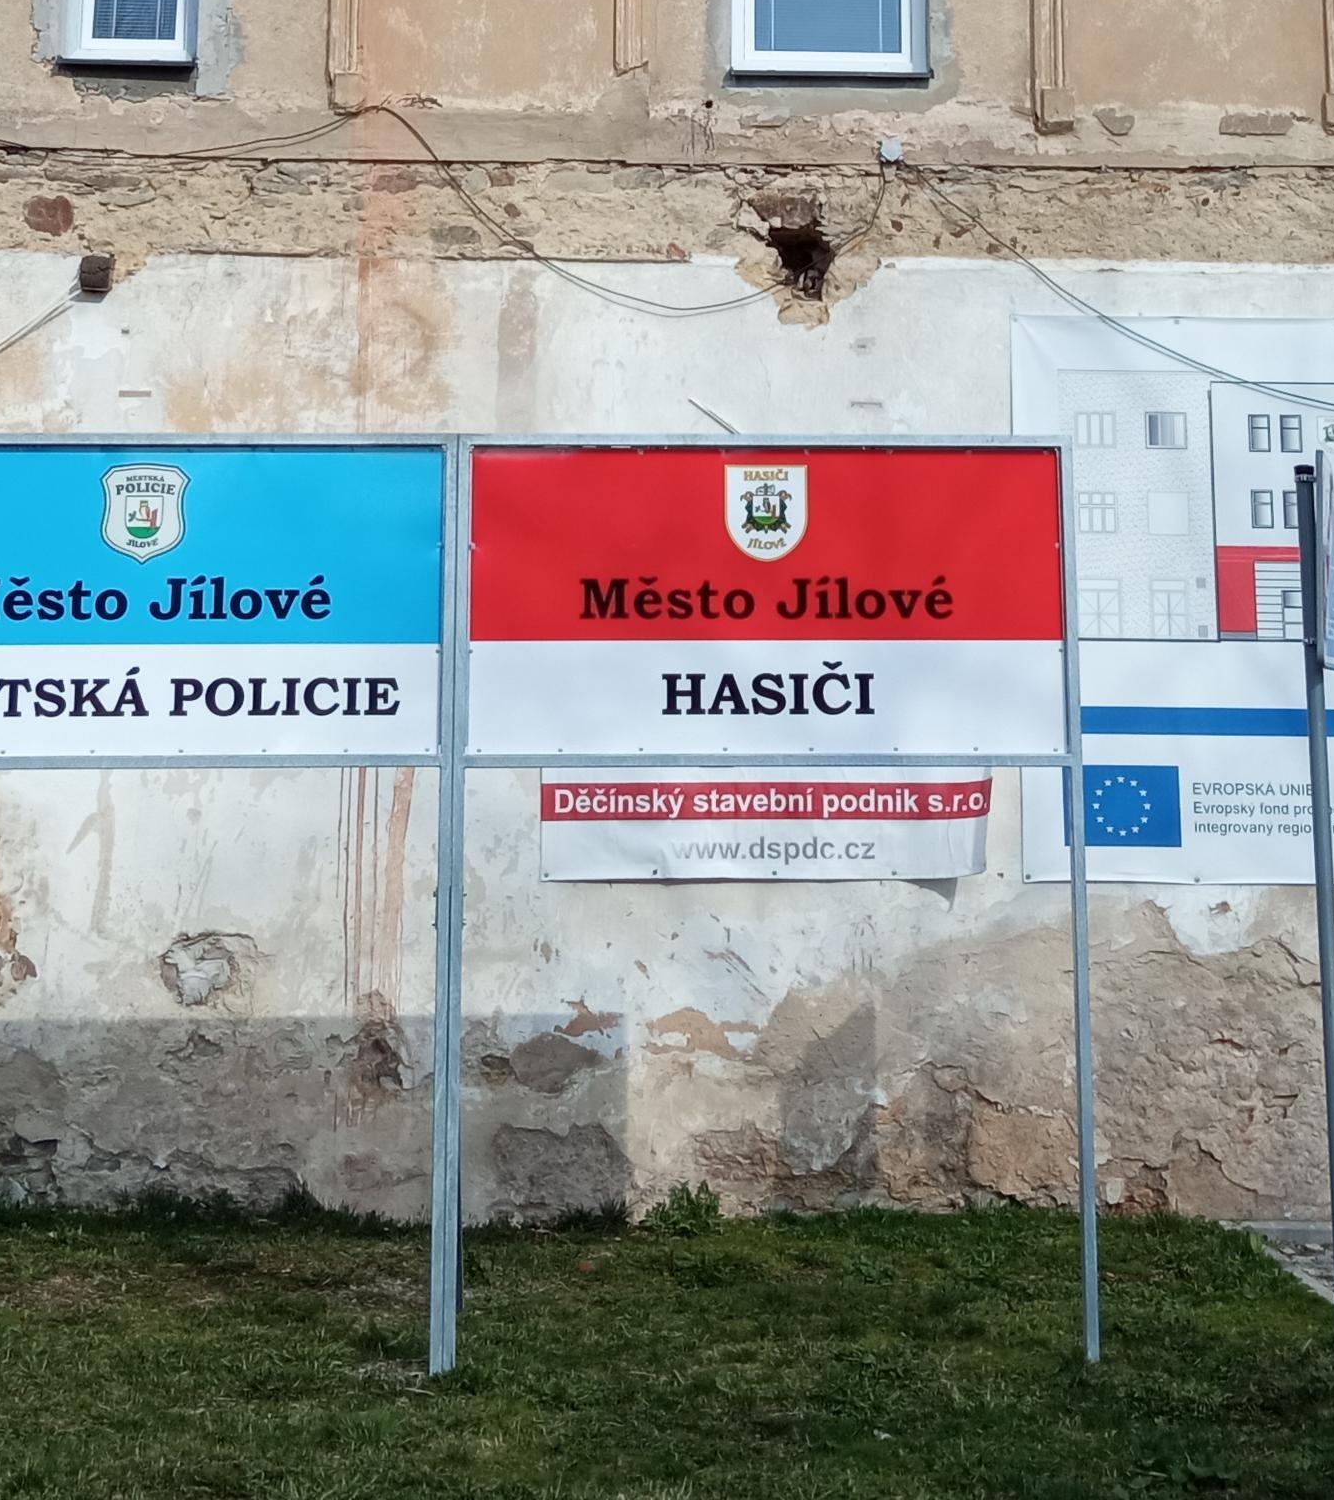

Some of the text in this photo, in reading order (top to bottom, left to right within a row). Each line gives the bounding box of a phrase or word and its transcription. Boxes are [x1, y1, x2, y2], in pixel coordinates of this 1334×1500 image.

[115, 483, 176, 495] POLICIE
[743, 468, 789, 481] HASIČI
[150, 574, 332, 621] Jílové
[579, 575, 955, 620] Město Jílové
[169, 677, 400, 717] POLICIE
[661, 661, 875, 716] HASIČI
[553, 786, 989, 820] Děčínský stavební podnik s.r.o.
[1192, 781, 1275, 796] EVROPSKÁ
[1193, 801, 1255, 817] Evropský
[1260, 802, 1289, 815] fond
[670, 836, 875, 867] www.dspdc.cz
